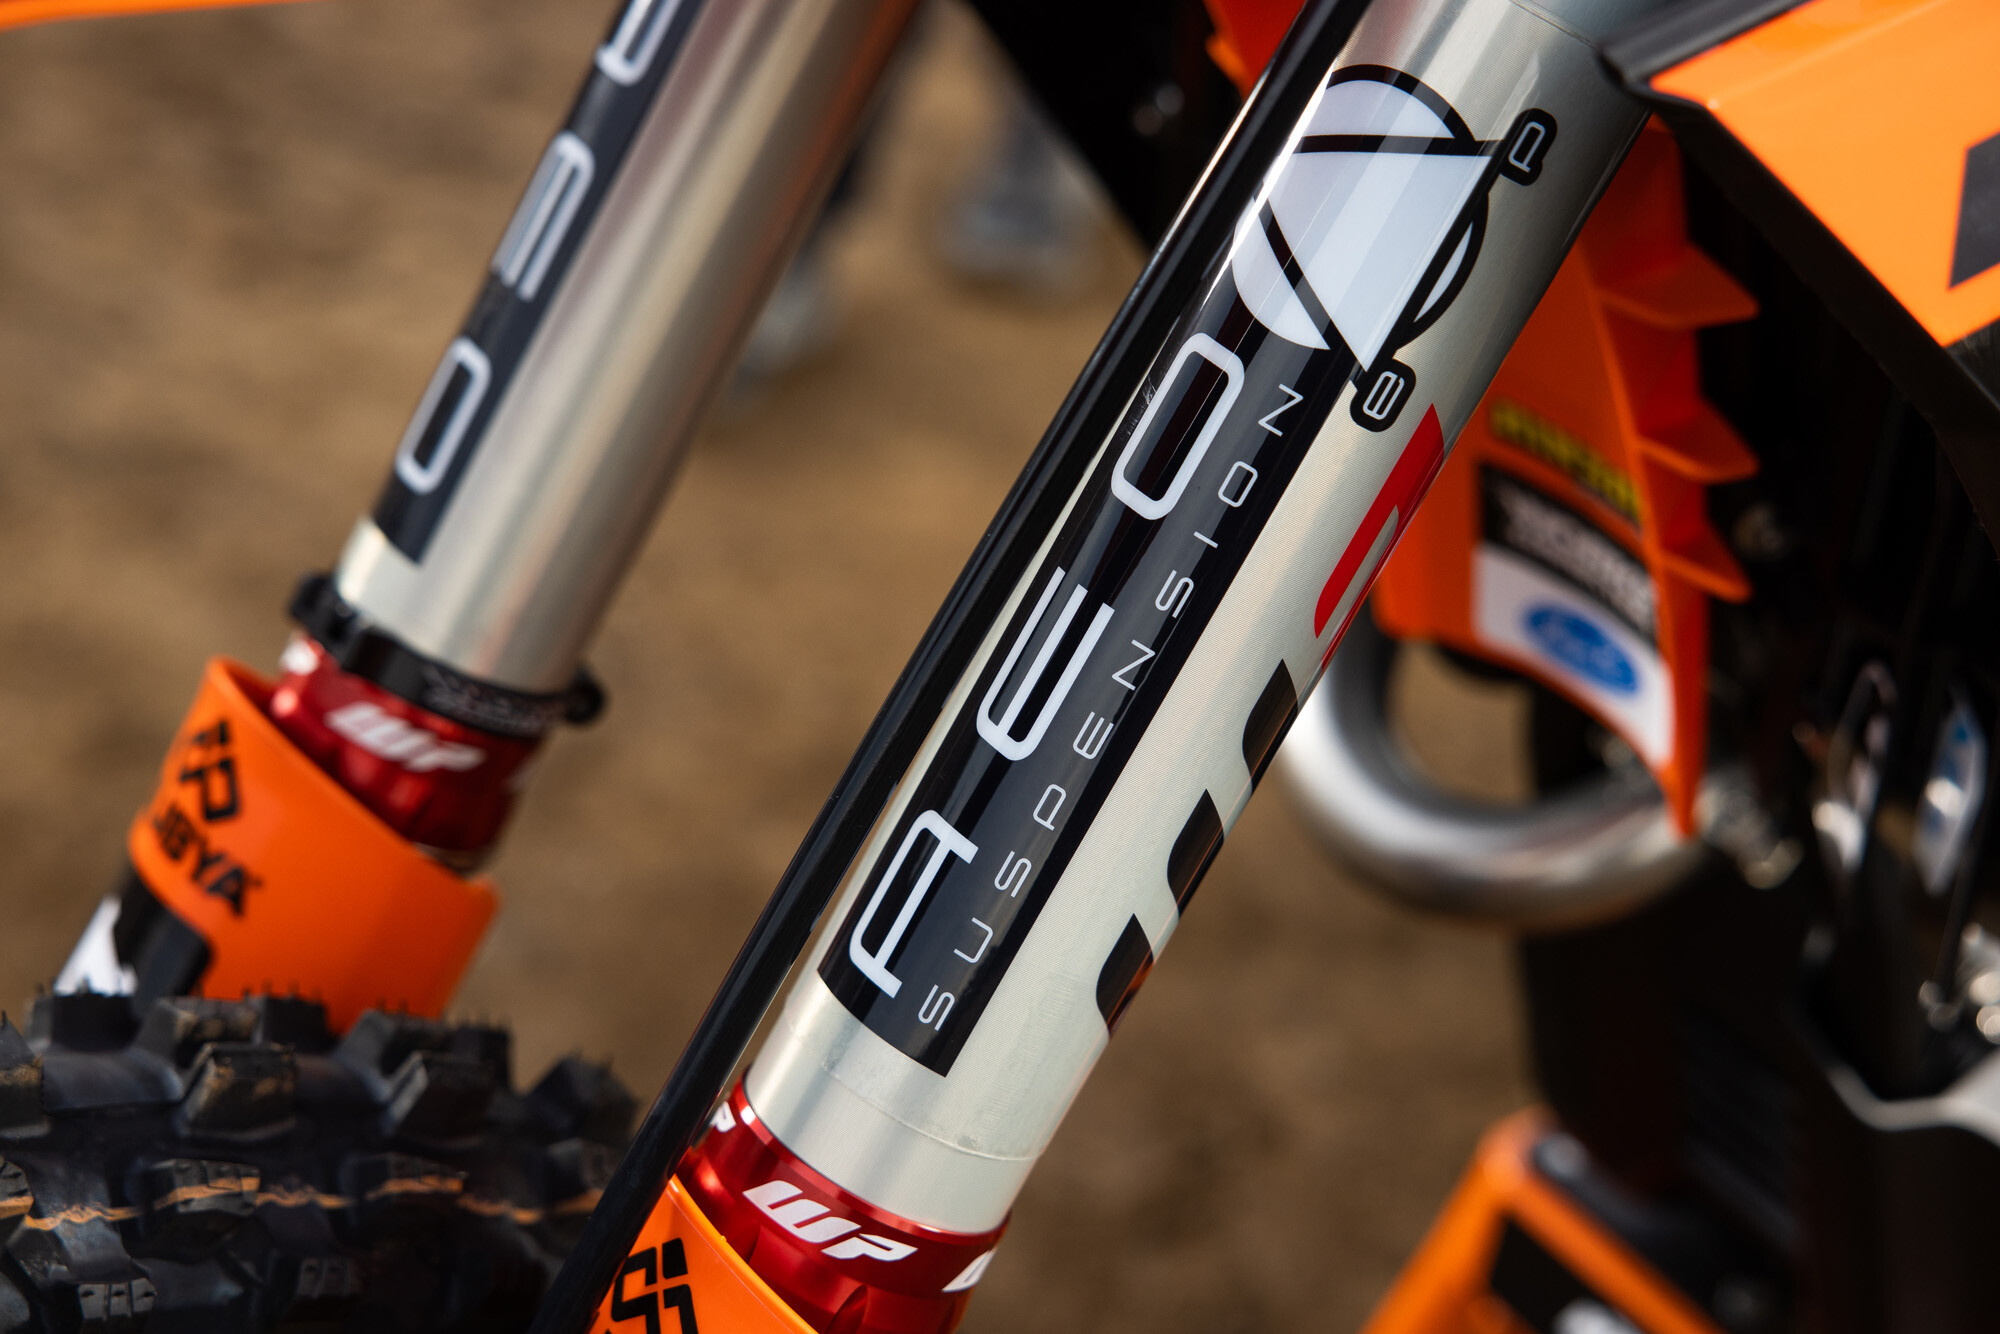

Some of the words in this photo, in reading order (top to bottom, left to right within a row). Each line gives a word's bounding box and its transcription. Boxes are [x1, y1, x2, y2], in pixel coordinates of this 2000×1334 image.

[848, 332, 1245, 998] AEO
[917, 383, 1304, 1031] SUSPENSION
[742, 1180, 918, 1262] WP
